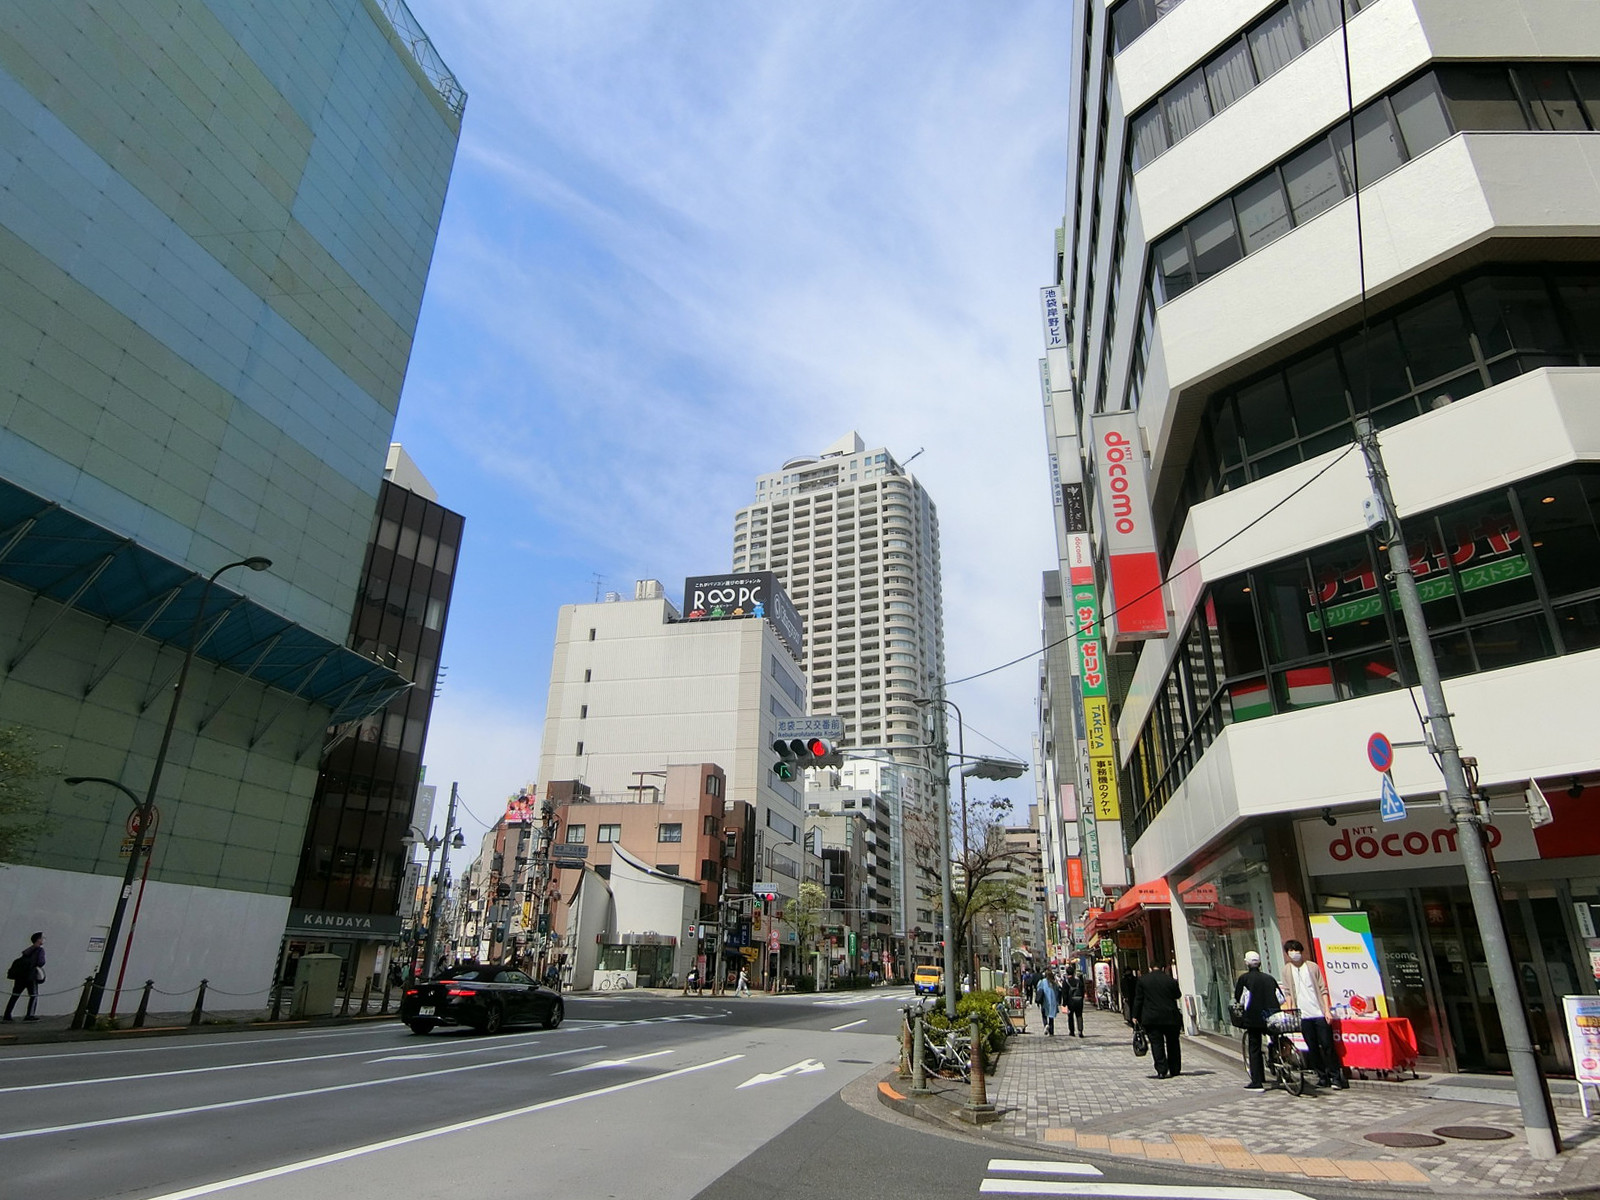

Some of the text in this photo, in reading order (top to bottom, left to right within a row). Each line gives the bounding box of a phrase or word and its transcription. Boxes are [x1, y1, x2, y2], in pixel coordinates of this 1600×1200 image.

[1045, 289, 1062, 345] 池袋岸野ビル
[1104, 431, 1135, 534] docomo
[1077, 606, 1102, 688] サイゼリヤ
[778, 719, 840, 731] 池袋二又交番前
[1091, 705, 1105, 749] TAKEYA
[1096, 760, 1111, 816] 事務機のタケヤ
[1329, 825, 1502, 861] docomo
[1352, 826, 1375, 835] NTT
[304, 914, 372, 928] KANDAYA
[1327, 960, 1369, 971] ahamo
